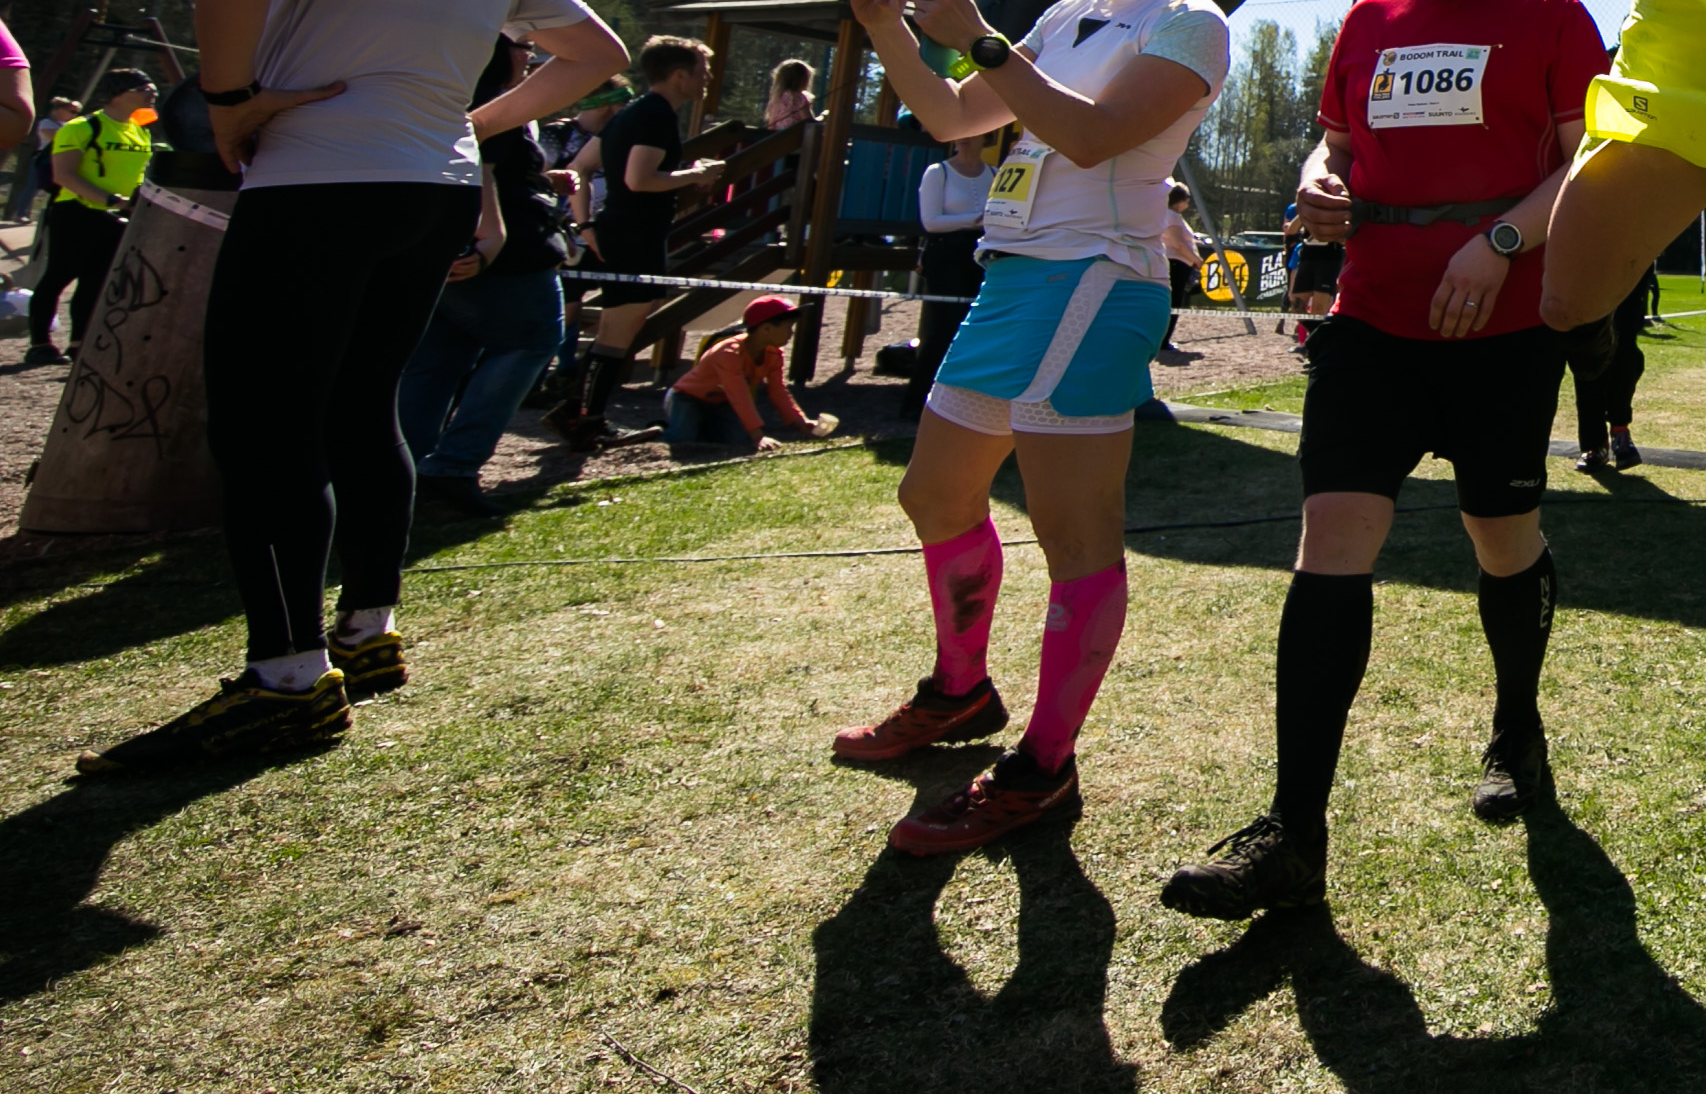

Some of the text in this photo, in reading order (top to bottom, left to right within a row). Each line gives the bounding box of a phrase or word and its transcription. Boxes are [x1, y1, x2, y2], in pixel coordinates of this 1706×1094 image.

[1400, 50, 1464, 61] BODOM TRAIL
[1400, 68, 1475, 96] 1086
[994, 167, 1026, 193] 127
